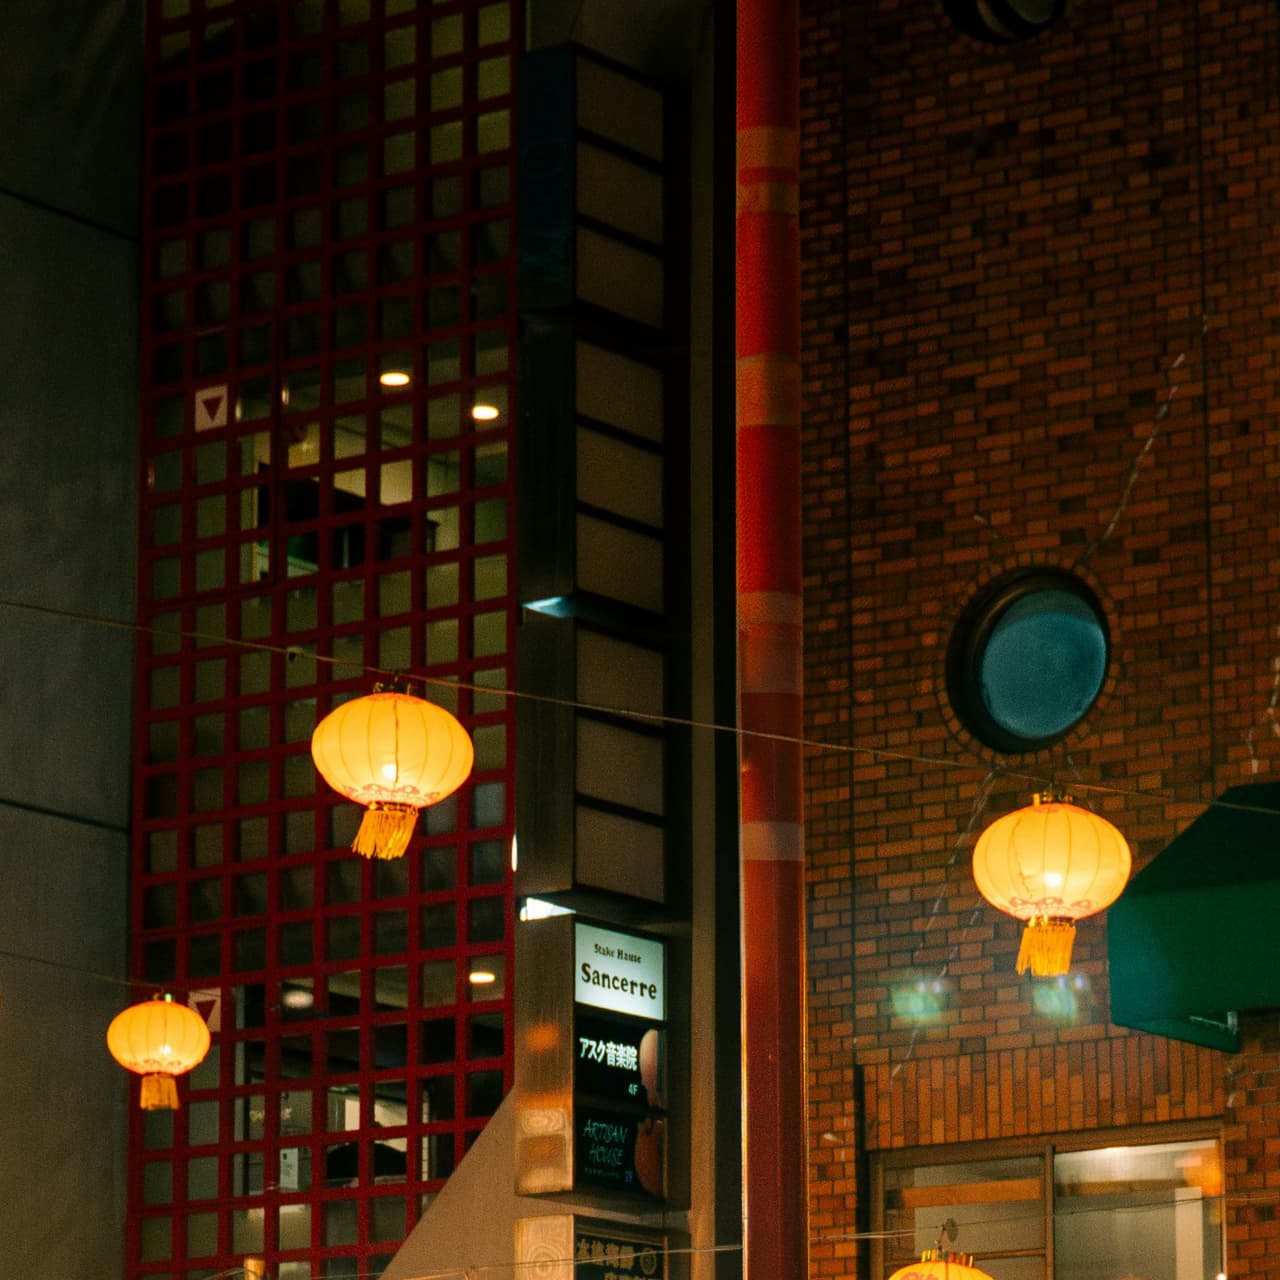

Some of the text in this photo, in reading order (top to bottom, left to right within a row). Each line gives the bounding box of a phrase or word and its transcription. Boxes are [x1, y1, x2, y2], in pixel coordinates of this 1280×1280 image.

[581, 962, 658, 1000] Sancerre
[579, 1037, 638, 1071] アスク音楽院
[627, 1083, 639, 1097] 4F
